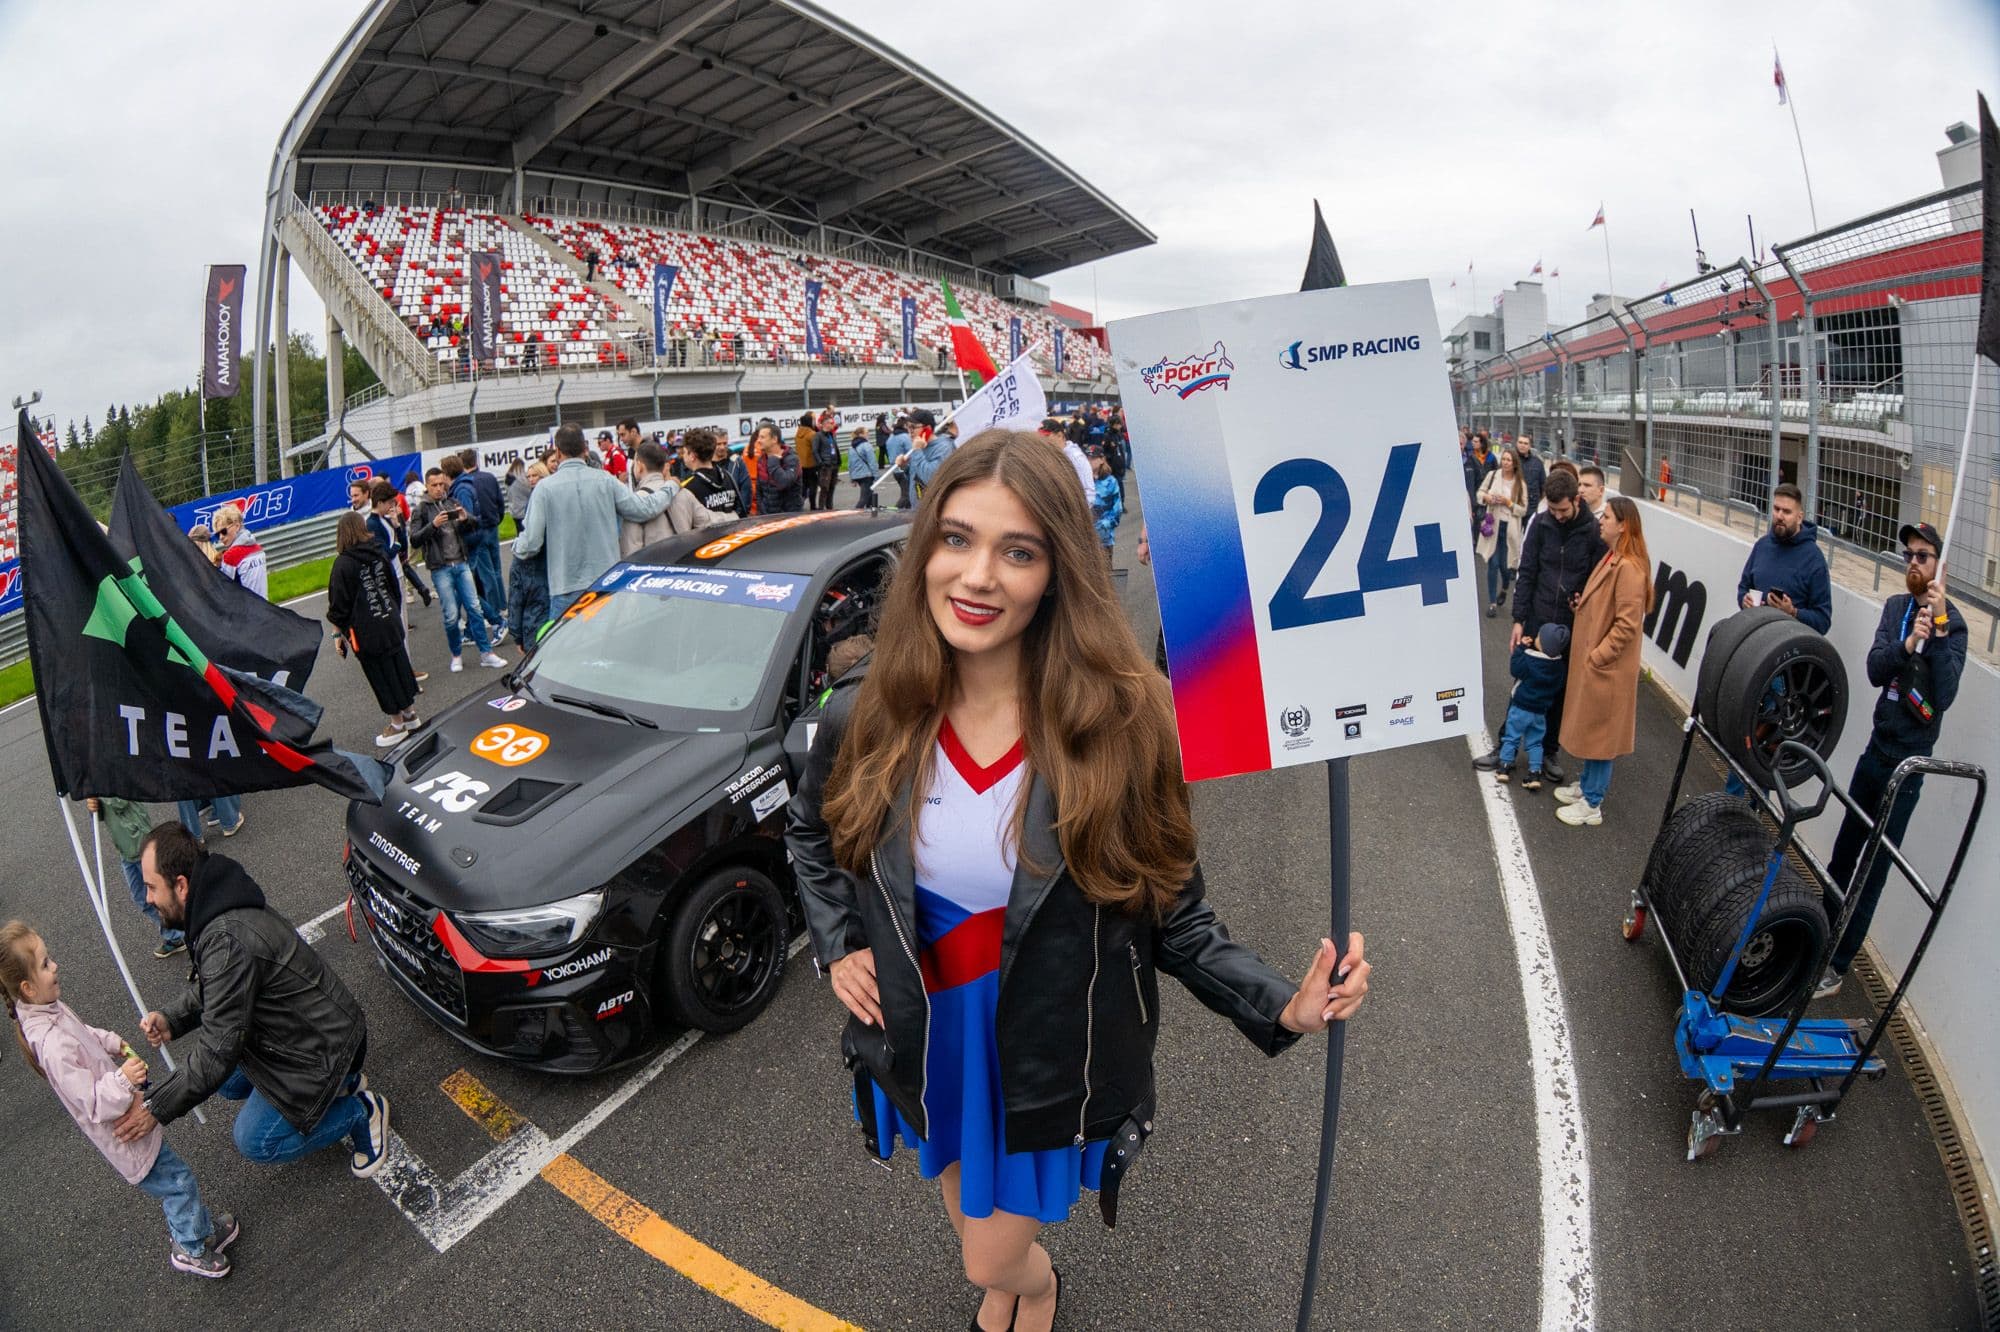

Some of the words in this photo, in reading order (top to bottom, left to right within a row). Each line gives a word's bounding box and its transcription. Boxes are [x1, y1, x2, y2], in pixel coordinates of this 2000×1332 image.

[1307, 344, 1348, 363] SMP
[1352, 335, 1420, 357] RACING
[1140, 364, 1163, 376] СМП
[1164, 361, 1216, 383] РСКГ
[484, 449, 519, 467] МИР
[1253, 442, 1459, 631] 24
[642, 576, 673, 590] SMP
[671, 577, 728, 596] RACING
[119, 704, 242, 760] TEA
[724, 765, 764, 794] TELECOM
[730, 764, 782, 804] INTEGRATION
[398, 802, 443, 834] TEAM
[369, 831, 421, 876] INNOSTAGE
